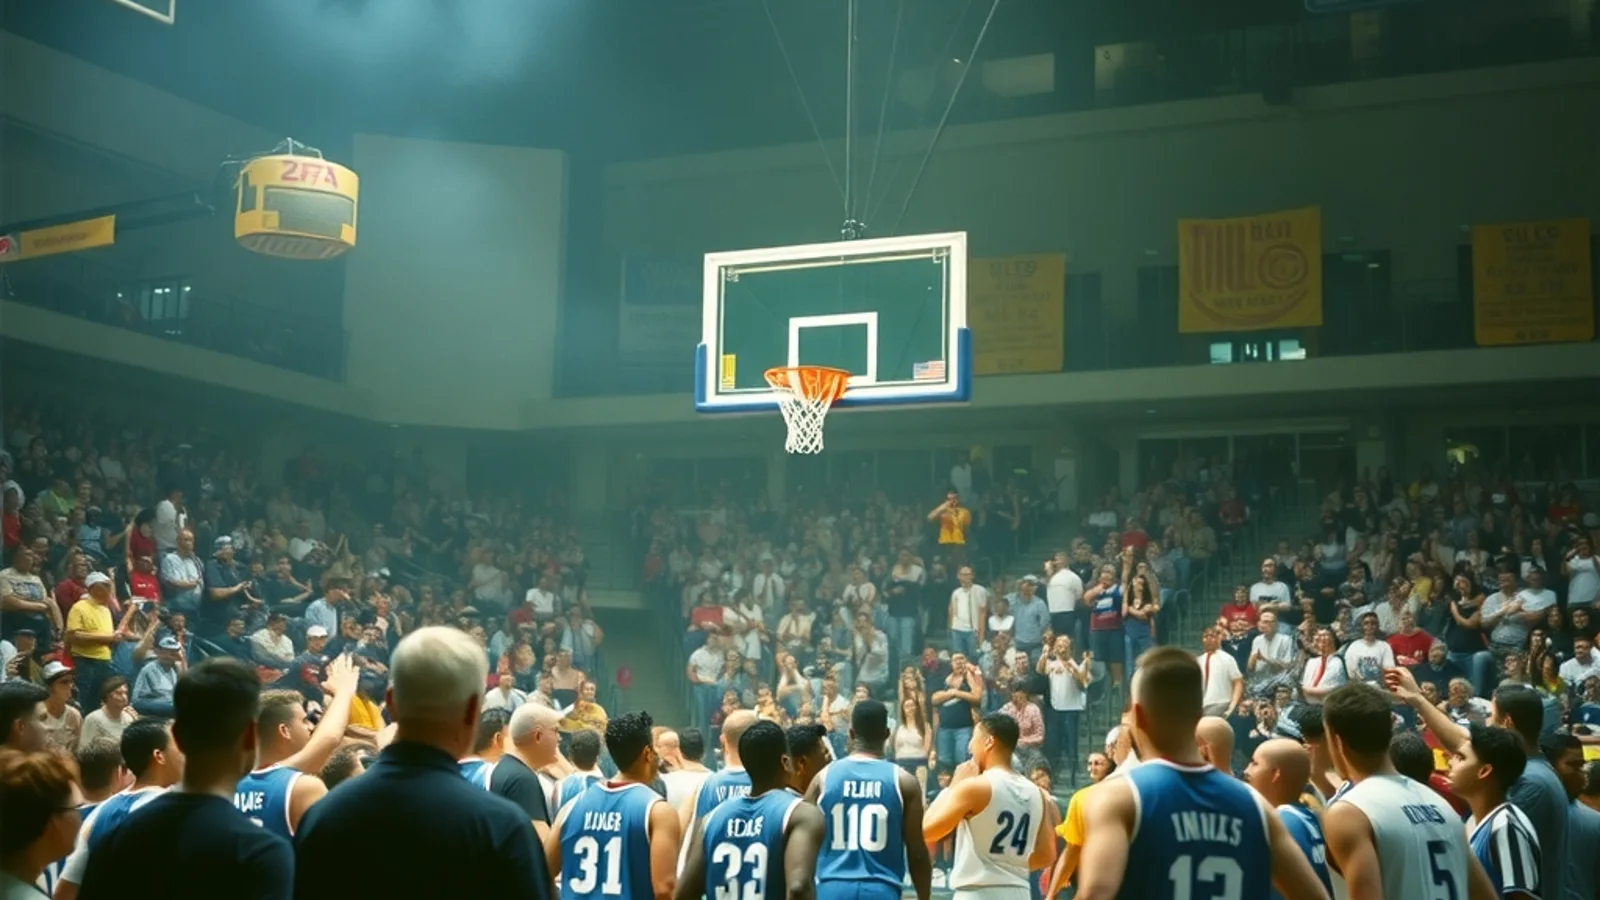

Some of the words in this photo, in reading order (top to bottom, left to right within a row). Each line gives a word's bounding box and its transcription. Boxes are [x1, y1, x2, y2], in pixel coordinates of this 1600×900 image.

[831, 803, 888, 852] 110
[989, 811, 1030, 856] 24
[569, 836, 622, 895] 31
[1426, 840, 1458, 900] 5
